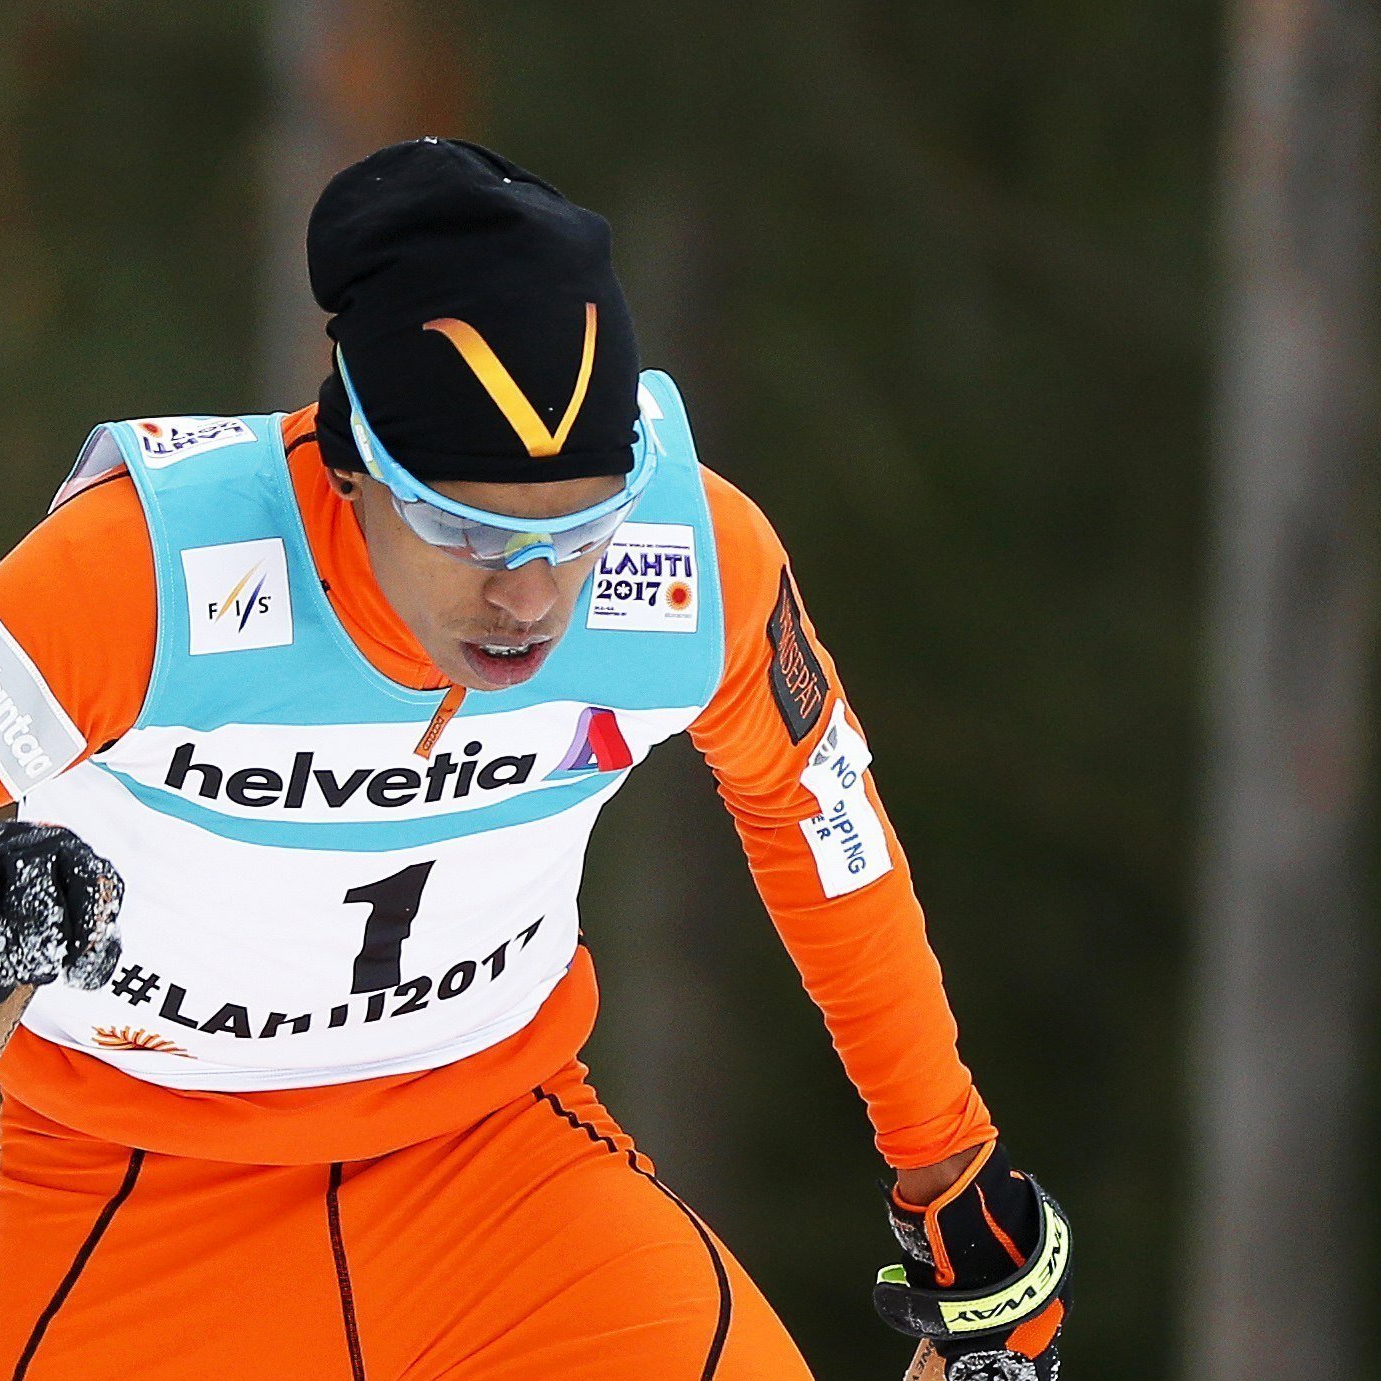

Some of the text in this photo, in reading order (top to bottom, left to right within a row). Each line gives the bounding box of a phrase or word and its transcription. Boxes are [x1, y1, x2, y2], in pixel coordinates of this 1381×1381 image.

[600, 551, 692, 578] LAHTI
[596, 579, 662, 606] 2017
[164, 741, 537, 809] helvetia
[342, 860, 437, 995] 1
[949, 1287, 1035, 1323] WAY
